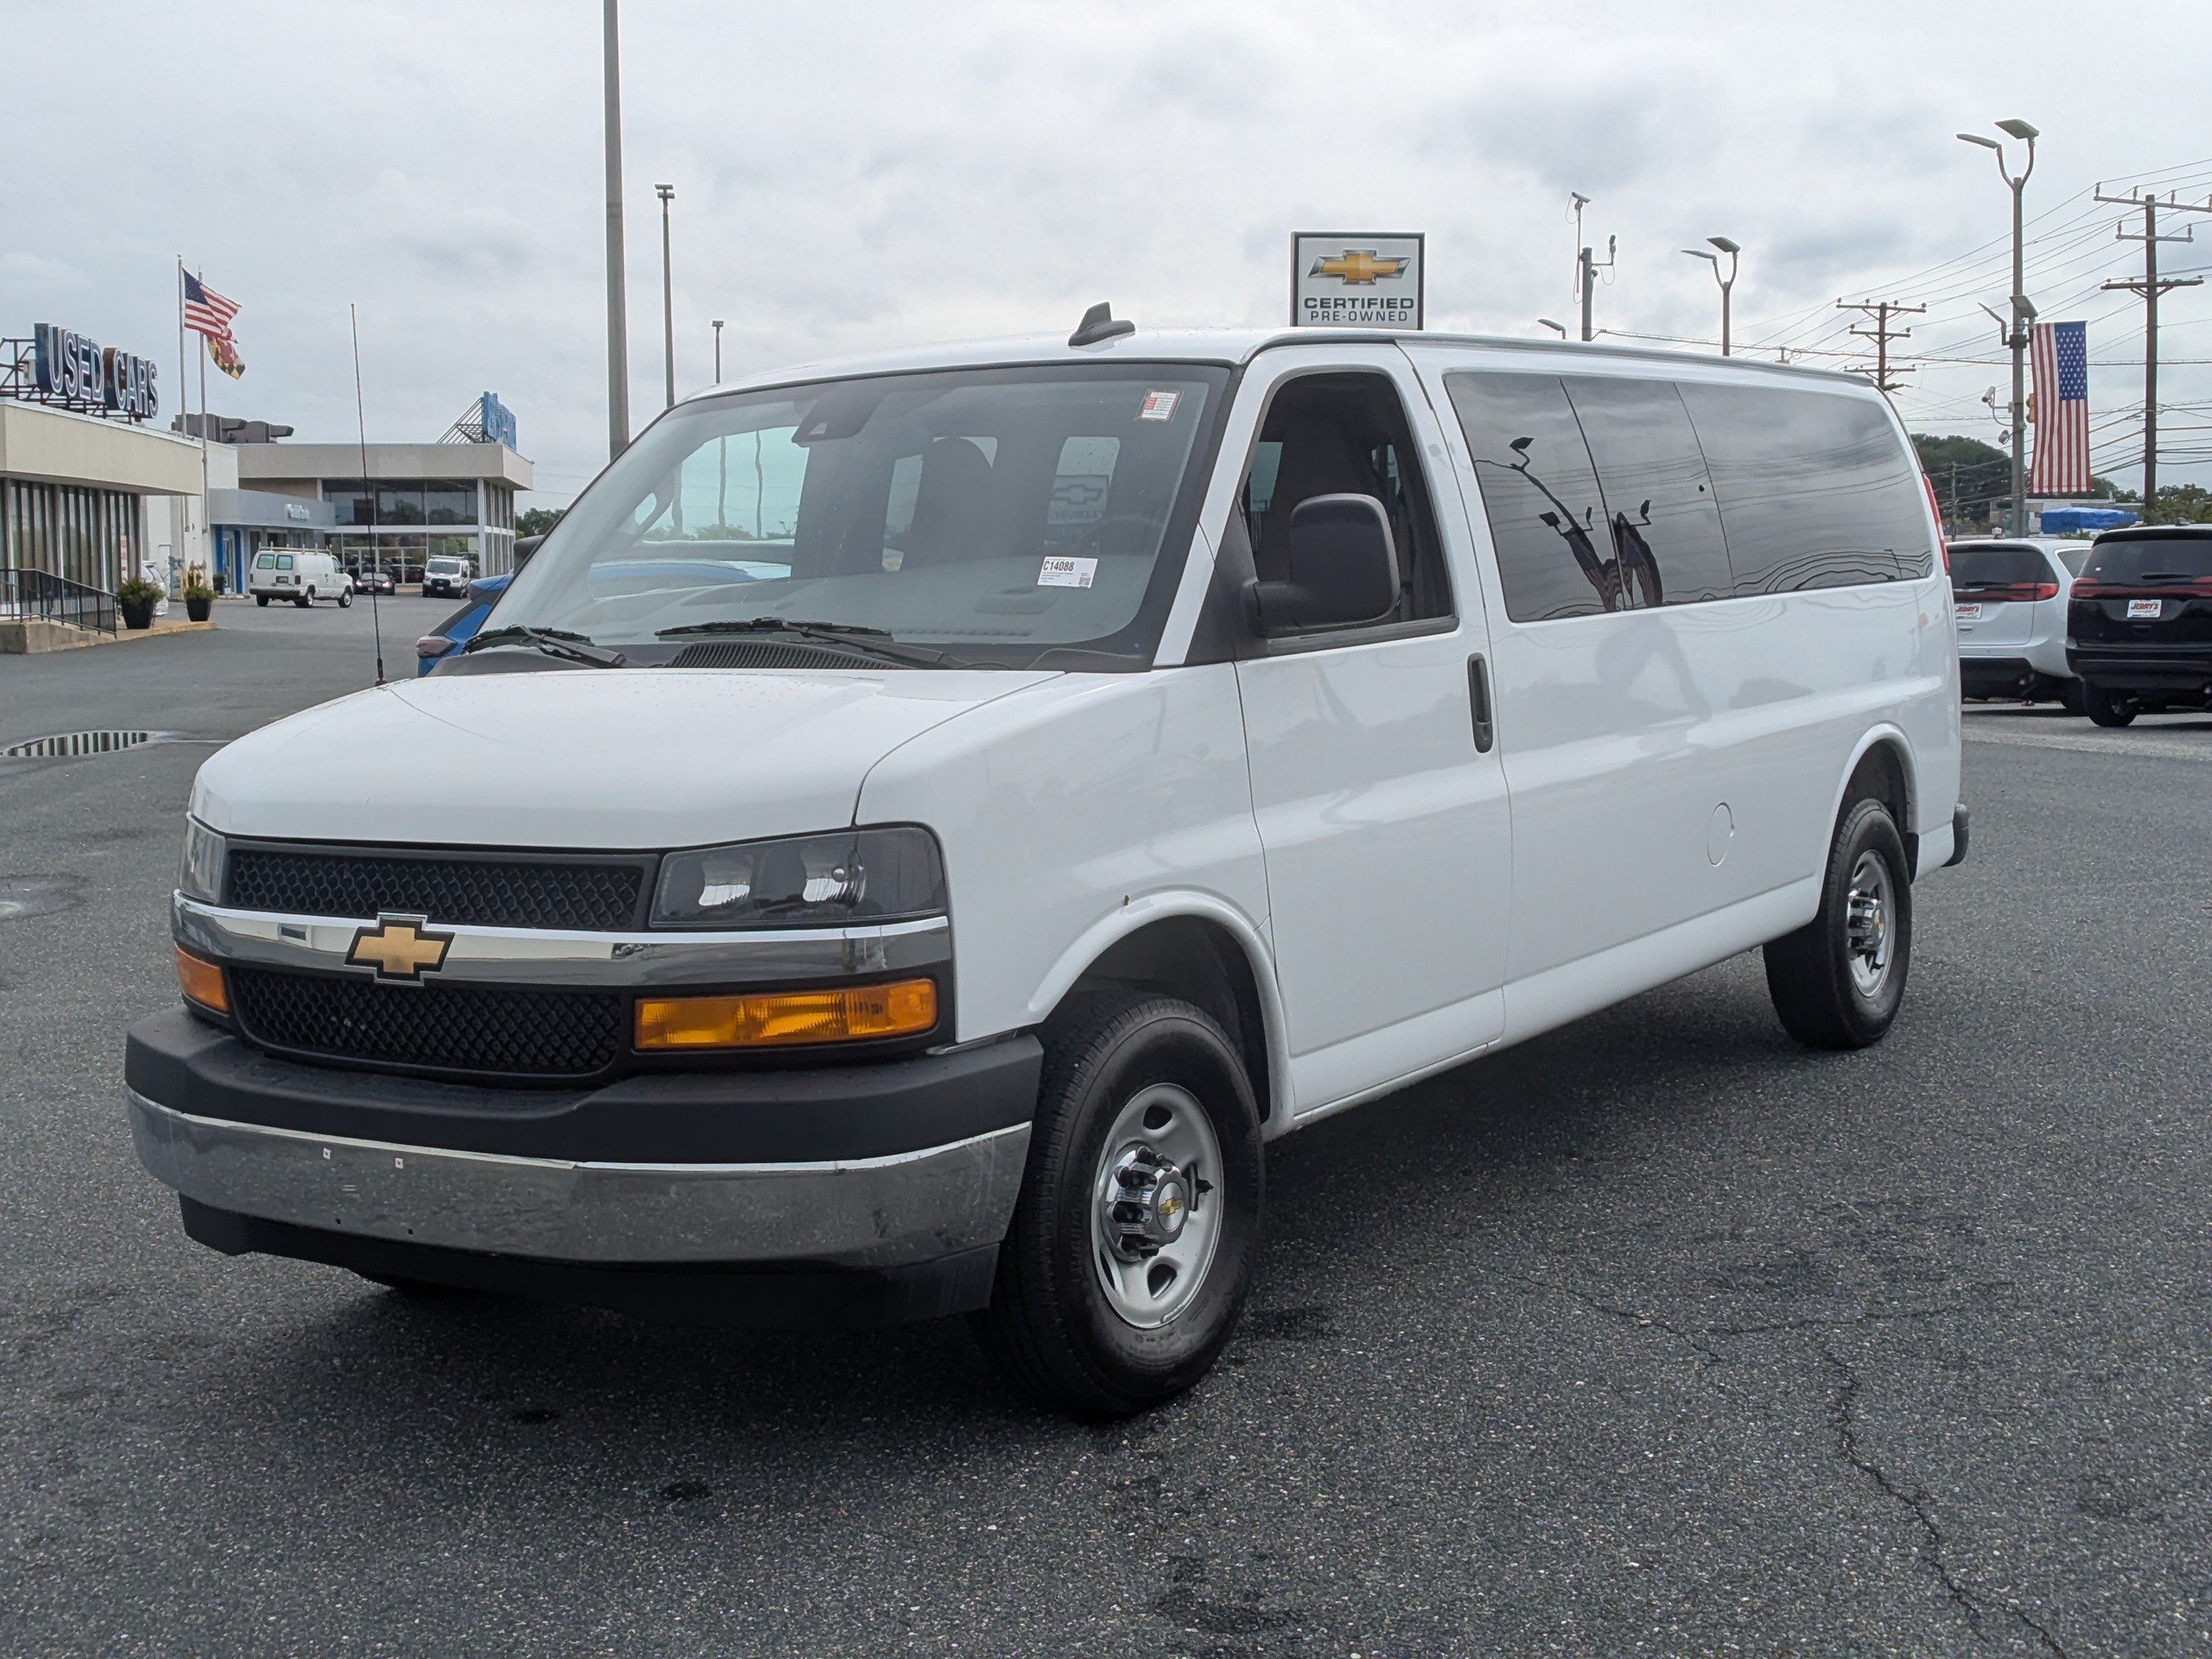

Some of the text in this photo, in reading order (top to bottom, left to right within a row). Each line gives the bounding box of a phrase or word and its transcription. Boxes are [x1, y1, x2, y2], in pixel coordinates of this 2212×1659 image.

[1304, 297, 1414, 309] CERTIFIED
[1310, 310, 1408, 321] PRE-OWNED
[46, 324, 158, 418] USED CARS
[1043, 561, 1075, 571] C14088
